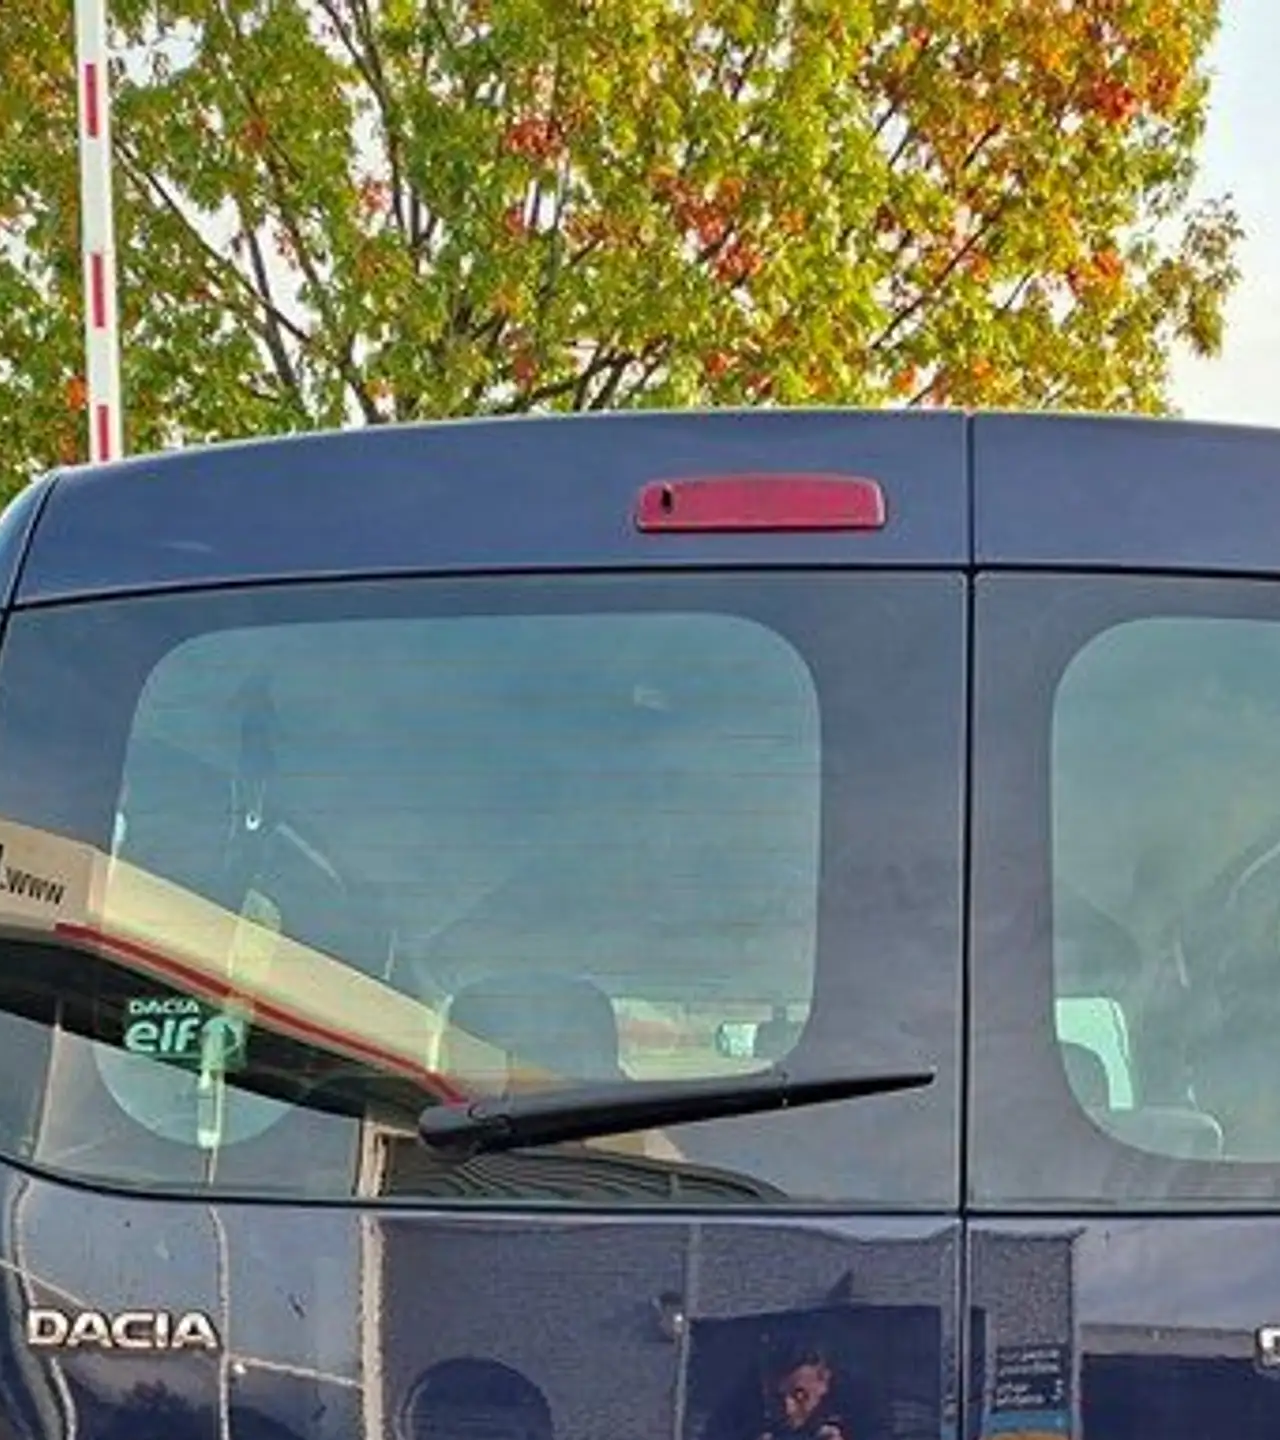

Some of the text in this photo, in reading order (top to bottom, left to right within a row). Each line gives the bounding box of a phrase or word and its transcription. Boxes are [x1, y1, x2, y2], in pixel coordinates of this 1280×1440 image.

[129, 999, 200, 1015] DACIA
[124, 1017, 200, 1053] elf
[27, 1308, 218, 1349] DACIA
